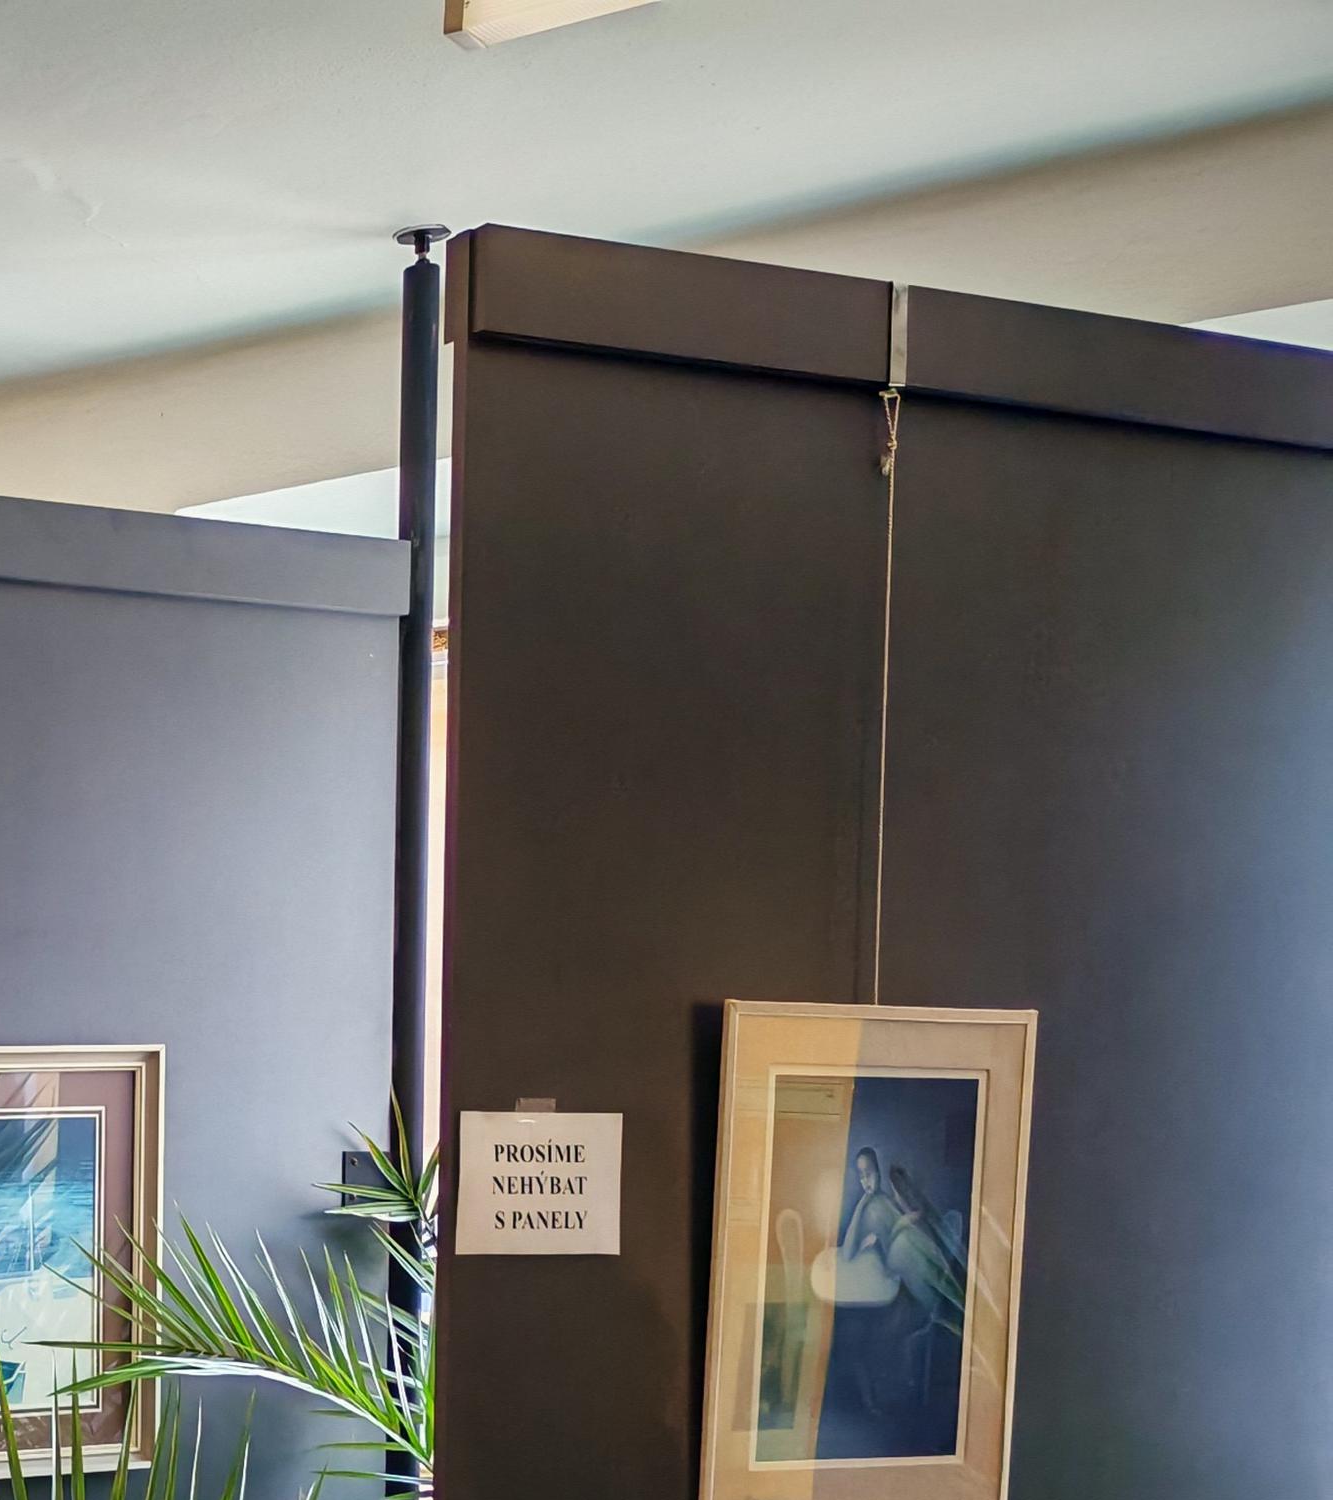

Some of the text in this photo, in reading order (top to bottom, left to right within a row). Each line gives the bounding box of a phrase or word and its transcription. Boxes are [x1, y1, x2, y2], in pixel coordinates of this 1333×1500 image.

[494, 1138, 585, 1163] PROSÍME
[492, 1170, 587, 1195] NEHÝBAT
[494, 1210, 588, 1230] S PANELY
